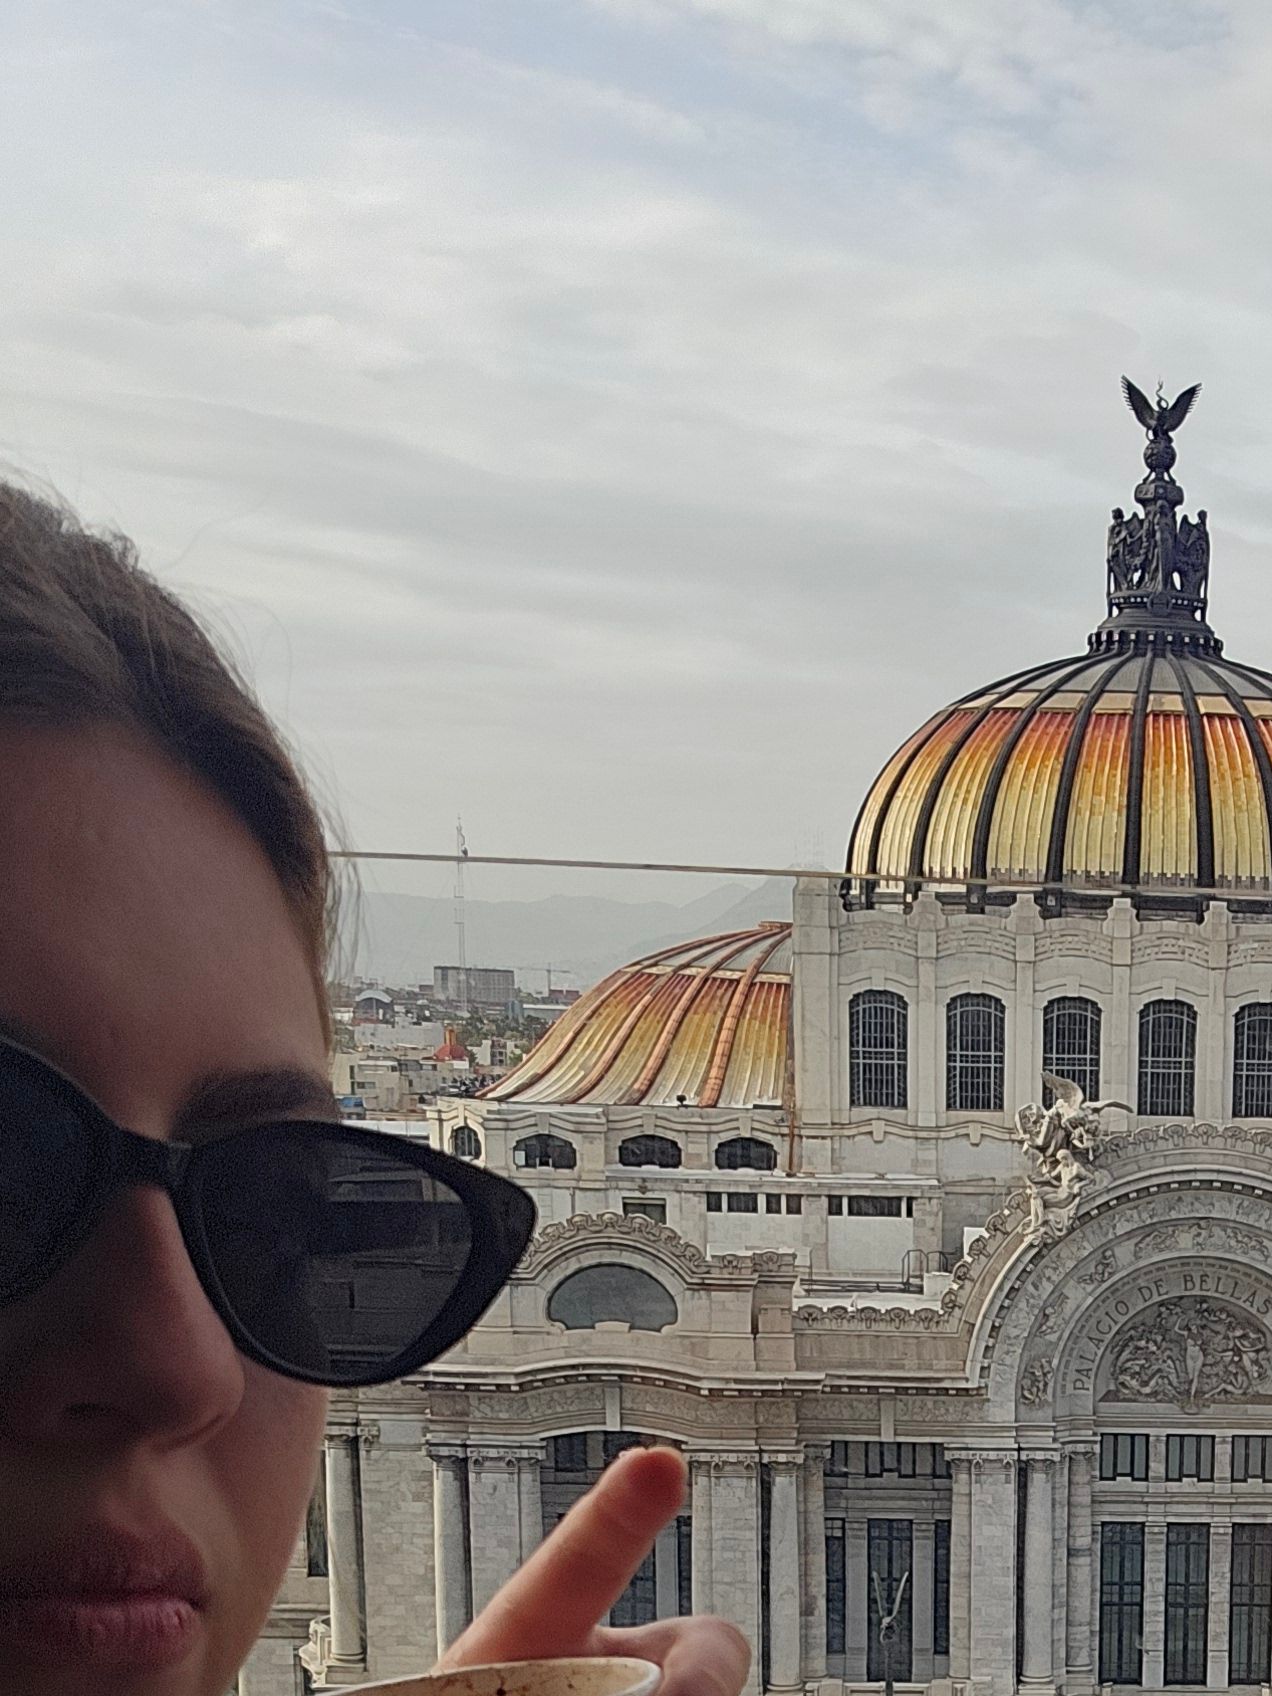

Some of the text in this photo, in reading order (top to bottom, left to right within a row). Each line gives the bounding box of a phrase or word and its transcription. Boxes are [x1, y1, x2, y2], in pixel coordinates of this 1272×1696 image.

[1072, 1300, 1130, 1391] PALACIO
[1137, 1279, 1169, 1303] DE
[1182, 1273, 1272, 1315] BELLAS
